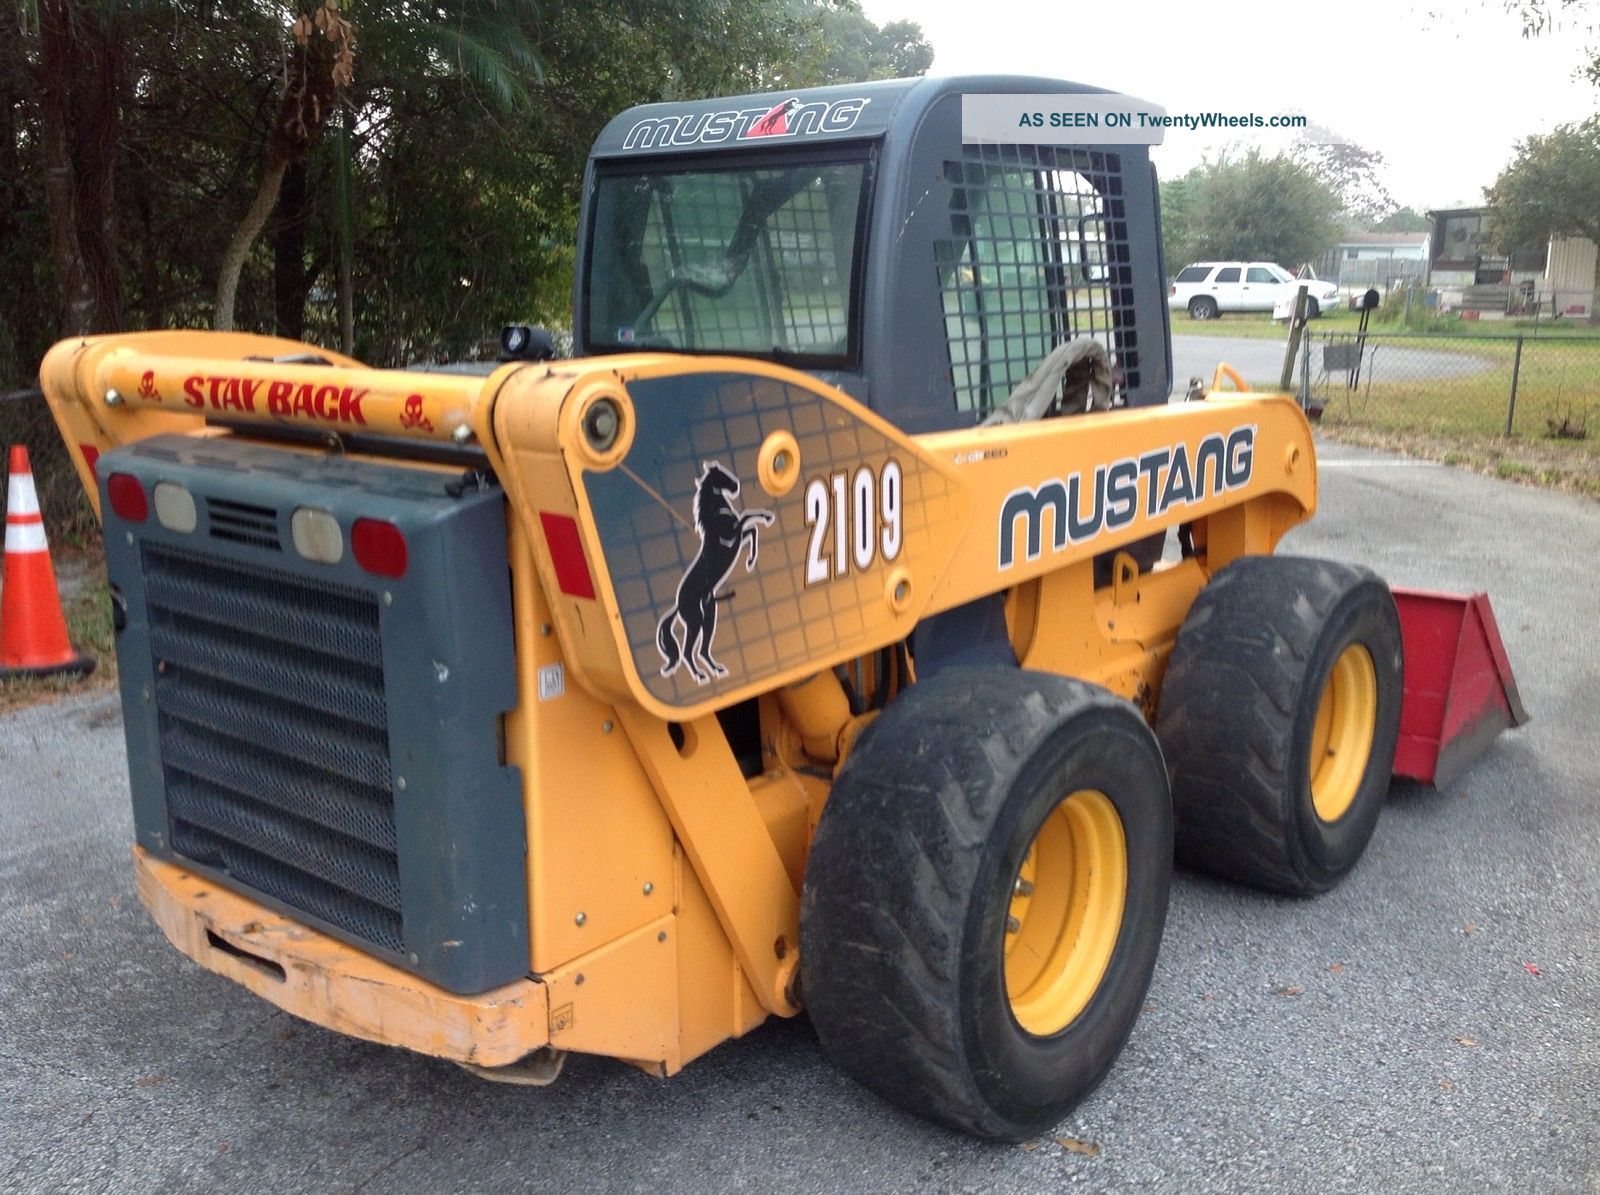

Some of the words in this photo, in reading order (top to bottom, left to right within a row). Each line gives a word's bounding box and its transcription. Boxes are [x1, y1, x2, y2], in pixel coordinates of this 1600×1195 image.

[622, 98, 871, 150] MUSTANG
[183, 376, 262, 412] STAY
[267, 381, 369, 426] BACK
[804, 457, 903, 589] 2109
[998, 424, 1257, 571] MUSTANG
